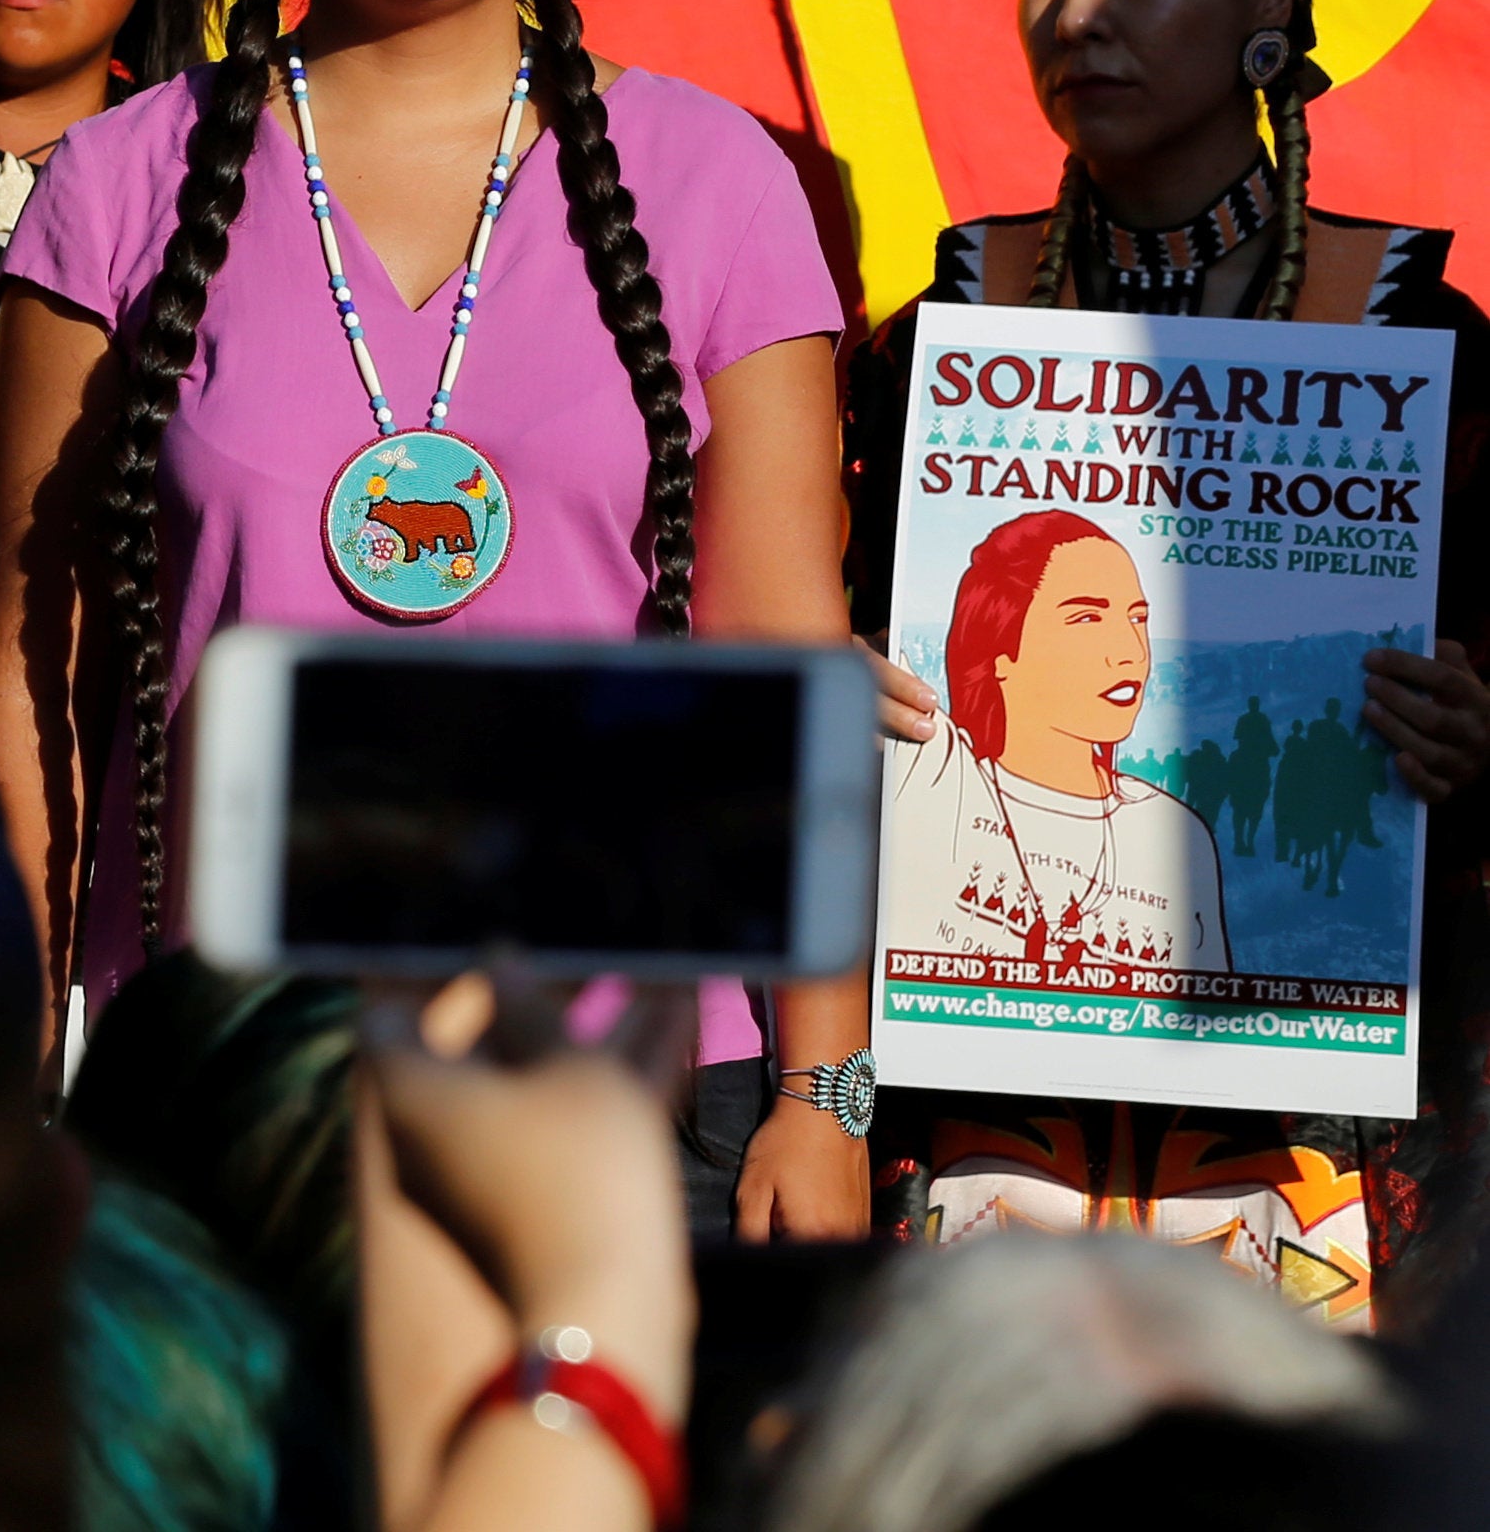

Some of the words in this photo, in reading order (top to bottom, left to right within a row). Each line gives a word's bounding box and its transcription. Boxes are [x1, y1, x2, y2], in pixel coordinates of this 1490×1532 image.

[929, 352, 1430, 431] SOLIDARITY
[1113, 424, 1234, 462] WITH
[919, 452, 1231, 512] STANDING
[1250, 471, 1420, 523] ROCK
[1138, 515, 1213, 539] STOP
[1224, 519, 1283, 544] THE
[1294, 524, 1419, 553] DAKOTA
[1162, 542, 1277, 571] ACCESS
[1287, 551, 1418, 579] PIPELINE
[1117, 885, 1170, 911] HEARTS
[936, 919, 956, 944] NO
[890, 952, 986, 981] DEFEND
[989, 959, 1040, 984] THE
[1046, 963, 1116, 989] LAND
[1131, 970, 1241, 1000] PROTECT
[1252, 979, 1302, 1002] THE
[1311, 982, 1398, 1009] WATER
[890, 990, 1398, 1046] www.change.org/RezpectOurWater
